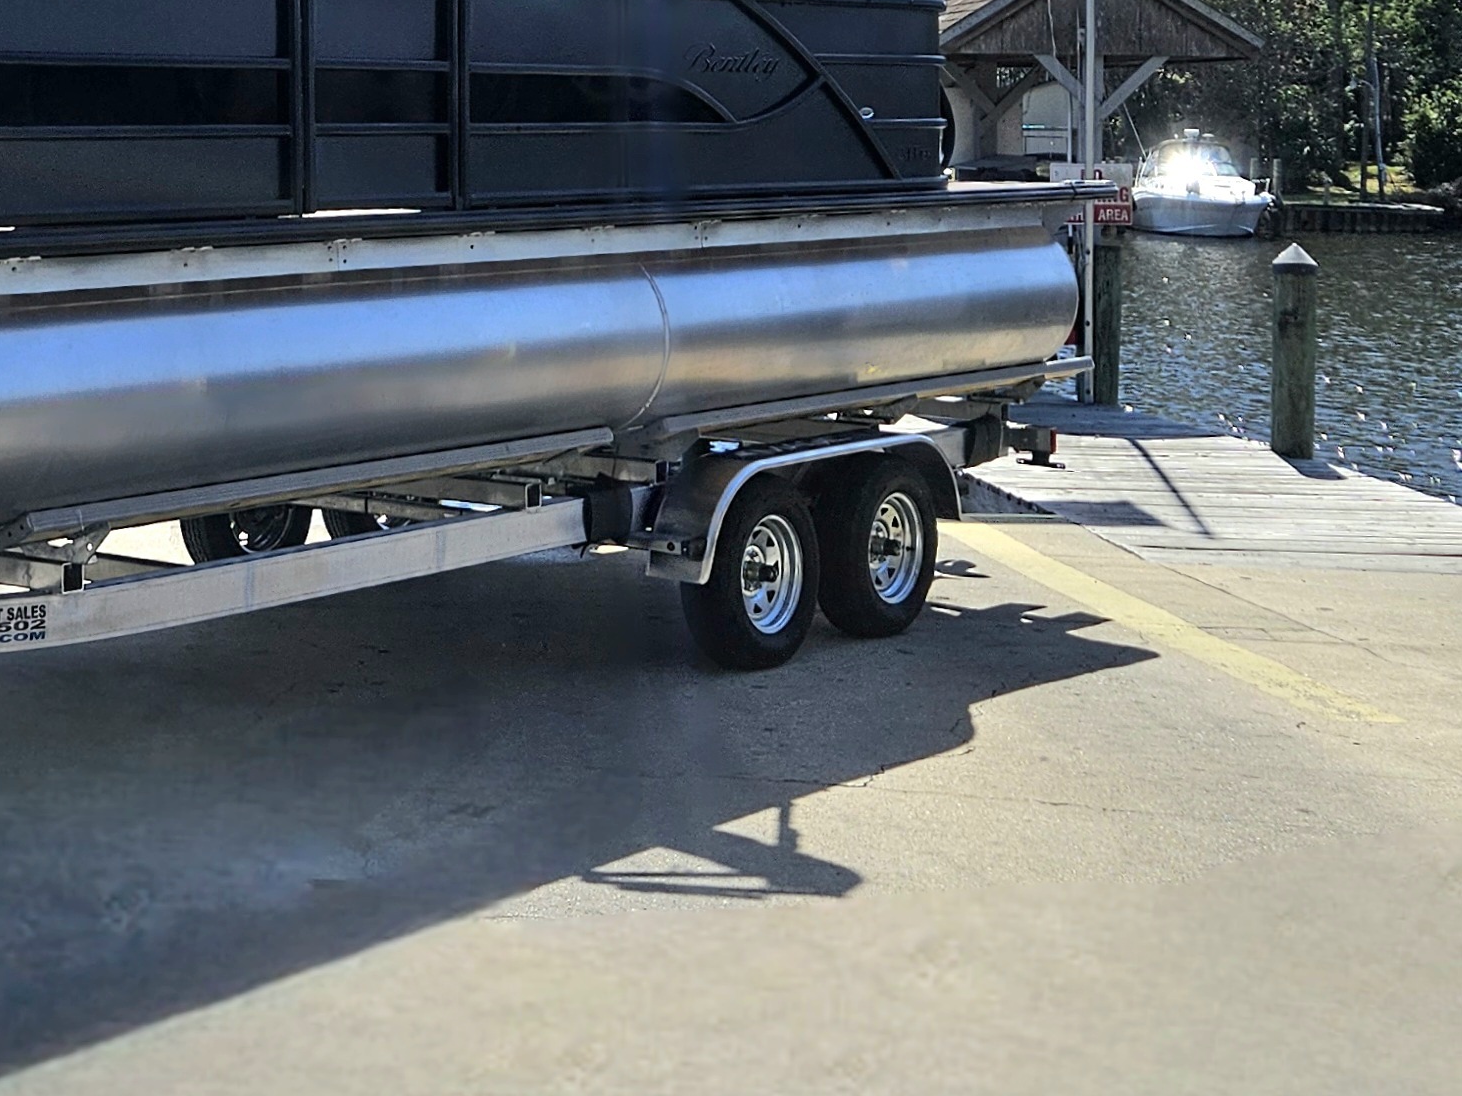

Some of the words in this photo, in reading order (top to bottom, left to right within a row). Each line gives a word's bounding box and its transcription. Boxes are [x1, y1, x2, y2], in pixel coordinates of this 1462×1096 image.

[683, 41, 780, 81] Bentley
[1098, 208, 1129, 221] AREA
[7, 604, 47, 621] SALES
